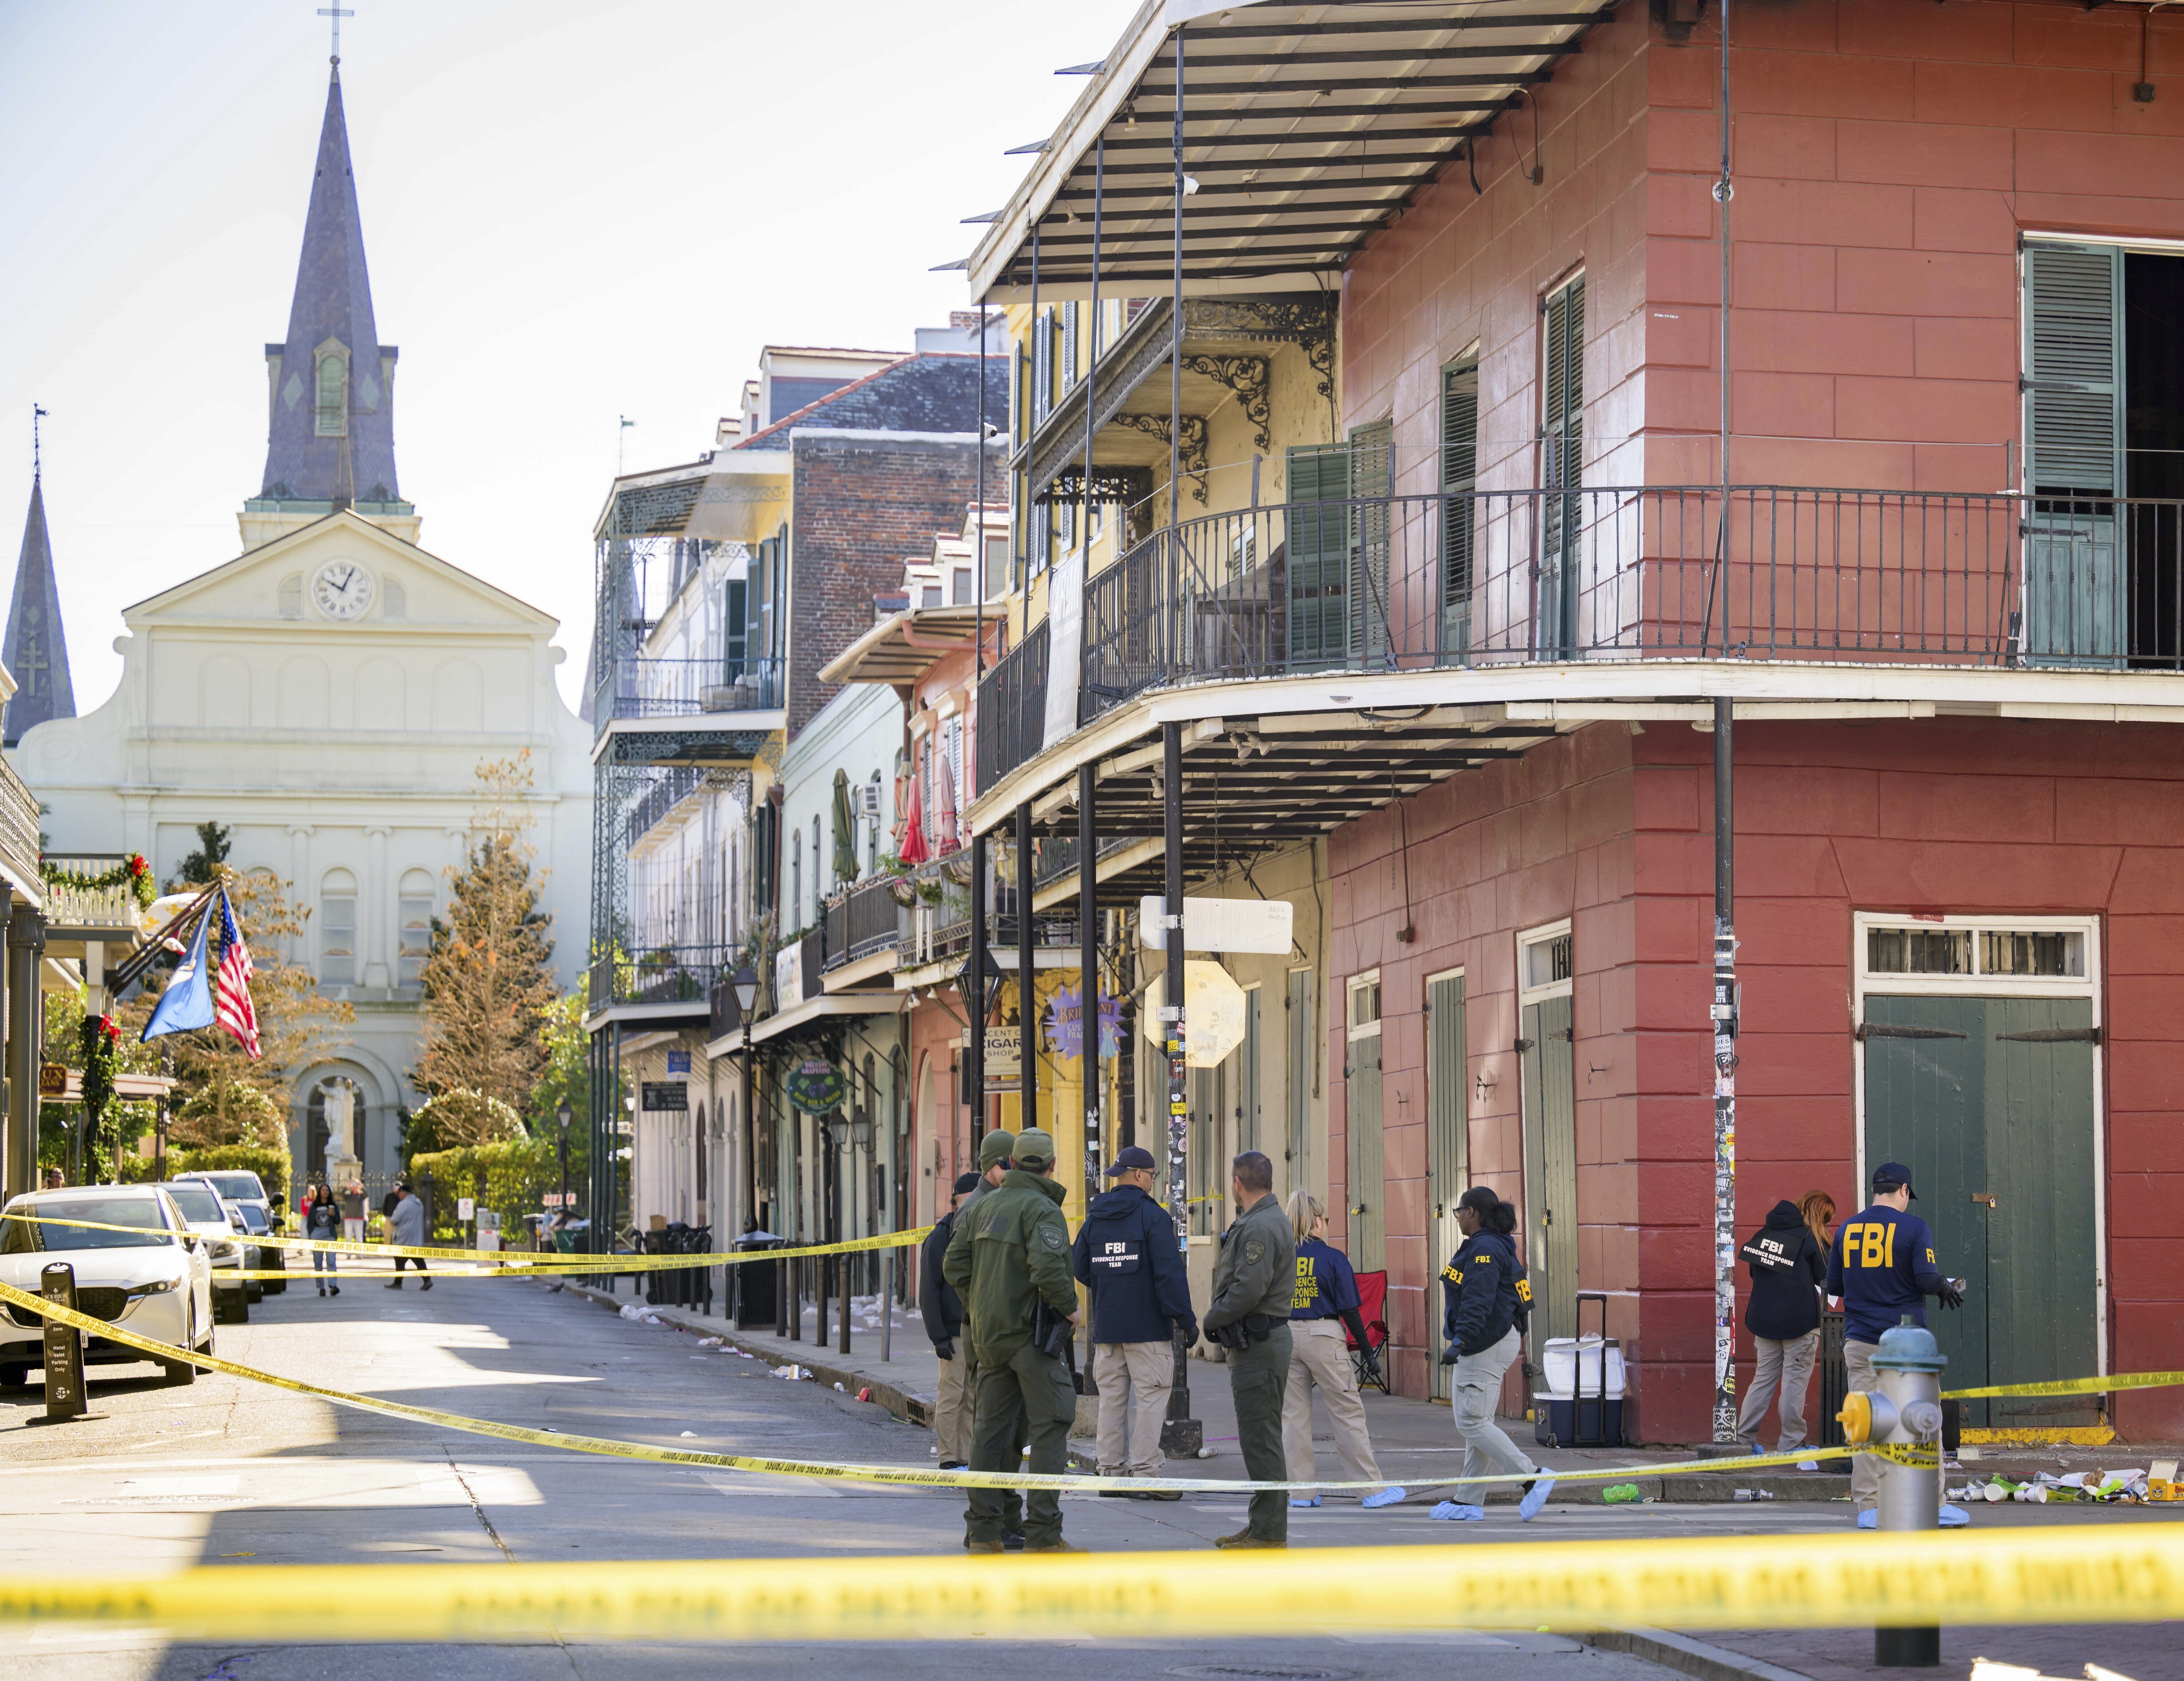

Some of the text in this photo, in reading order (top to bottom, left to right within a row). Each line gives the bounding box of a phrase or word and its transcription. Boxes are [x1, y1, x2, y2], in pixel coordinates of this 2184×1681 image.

[984, 1039, 1021, 1048] IGAR
[43, 1070, 63, 1079] UX
[1105, 1242, 1125, 1254] FBI
[1760, 1238, 1784, 1254] FBI
[1843, 1223, 1896, 1268] FBI
[1743, 1246, 1794, 1266] EVIDENCE RESPONSE
[1761, 1257, 1774, 1266] TEAM
[1926, 1248, 1935, 1264] FB
[1297, 1257, 1314, 1276] BI
[1443, 1265, 1464, 1285] FBI
[1294, 1287, 1318, 1297] PONSE
[1515, 1279, 1533, 1304] FB
[661, 1451, 738, 1466] CRIME SCENE DO NOT CROSS
[765, 1461, 846, 1475] CRIME SCENE DO NOT CROSS
[874, 1468, 960, 1483] CRIME SCENE DO NOT CROSS
